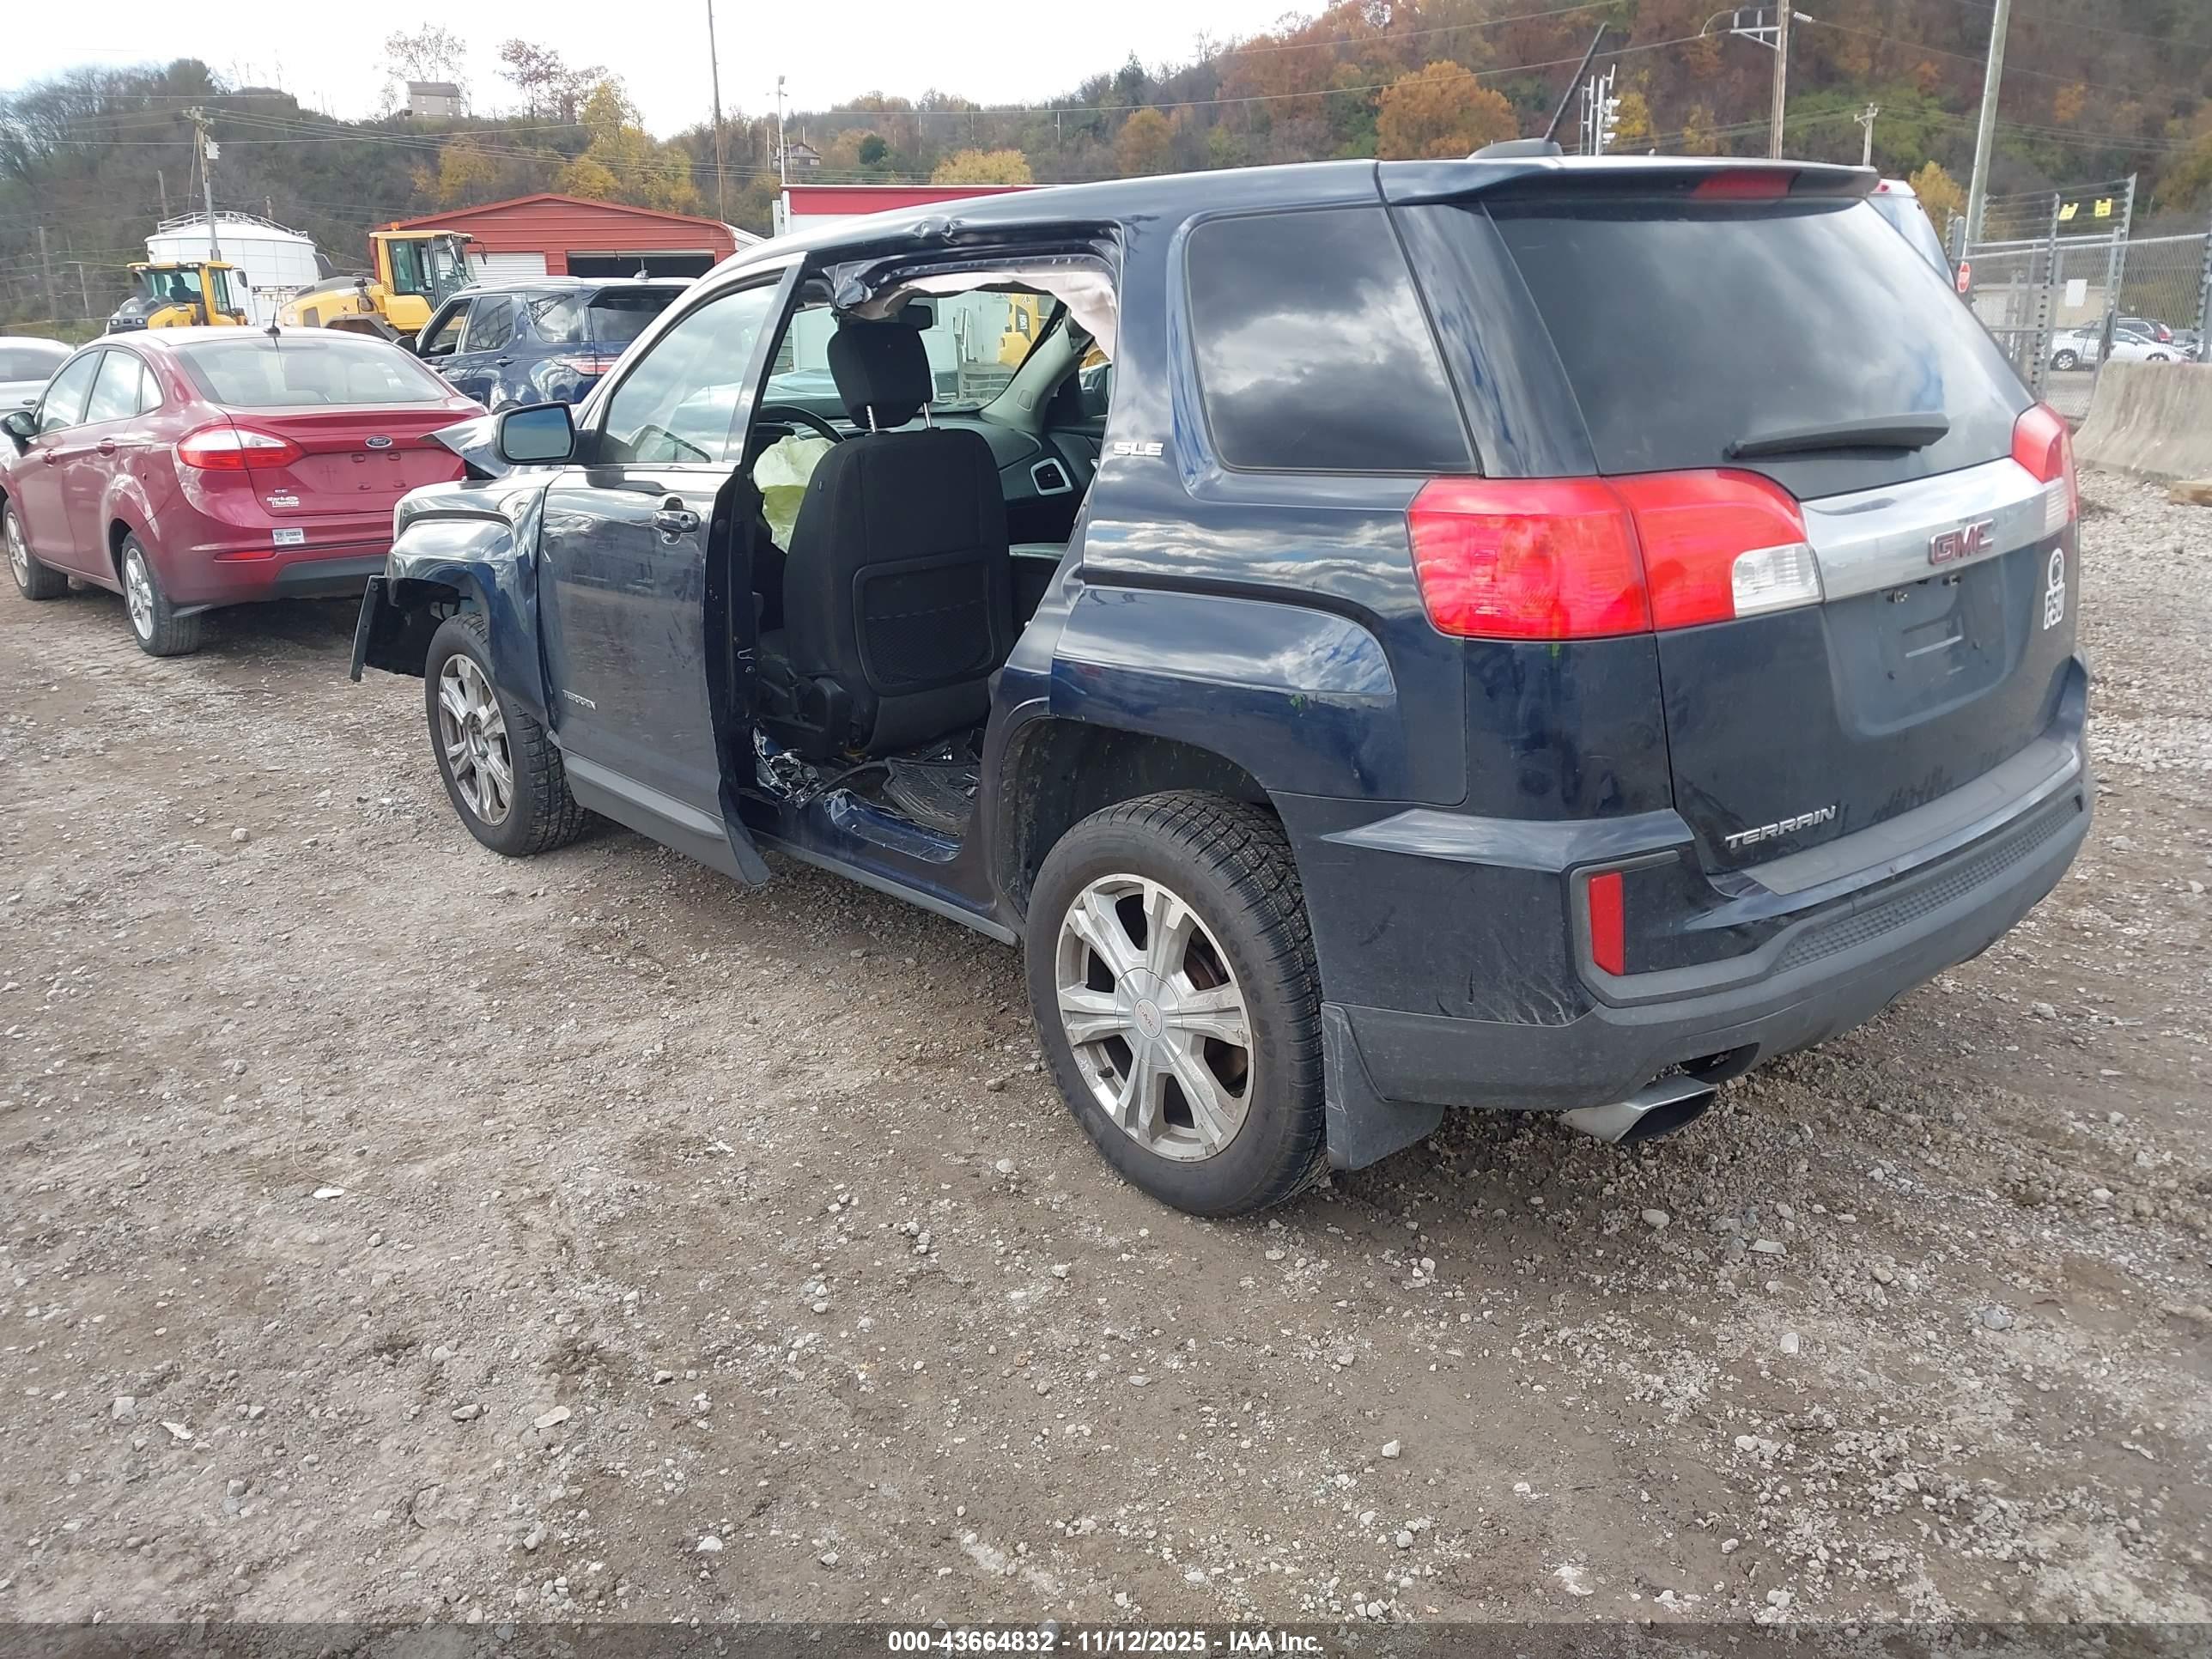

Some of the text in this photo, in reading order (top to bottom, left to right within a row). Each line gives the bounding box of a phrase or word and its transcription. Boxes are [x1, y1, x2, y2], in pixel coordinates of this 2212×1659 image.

[1113, 441, 1164, 457] SLE
[1929, 518, 1995, 565] GMC
[1725, 805, 1837, 849] TERRAIN
